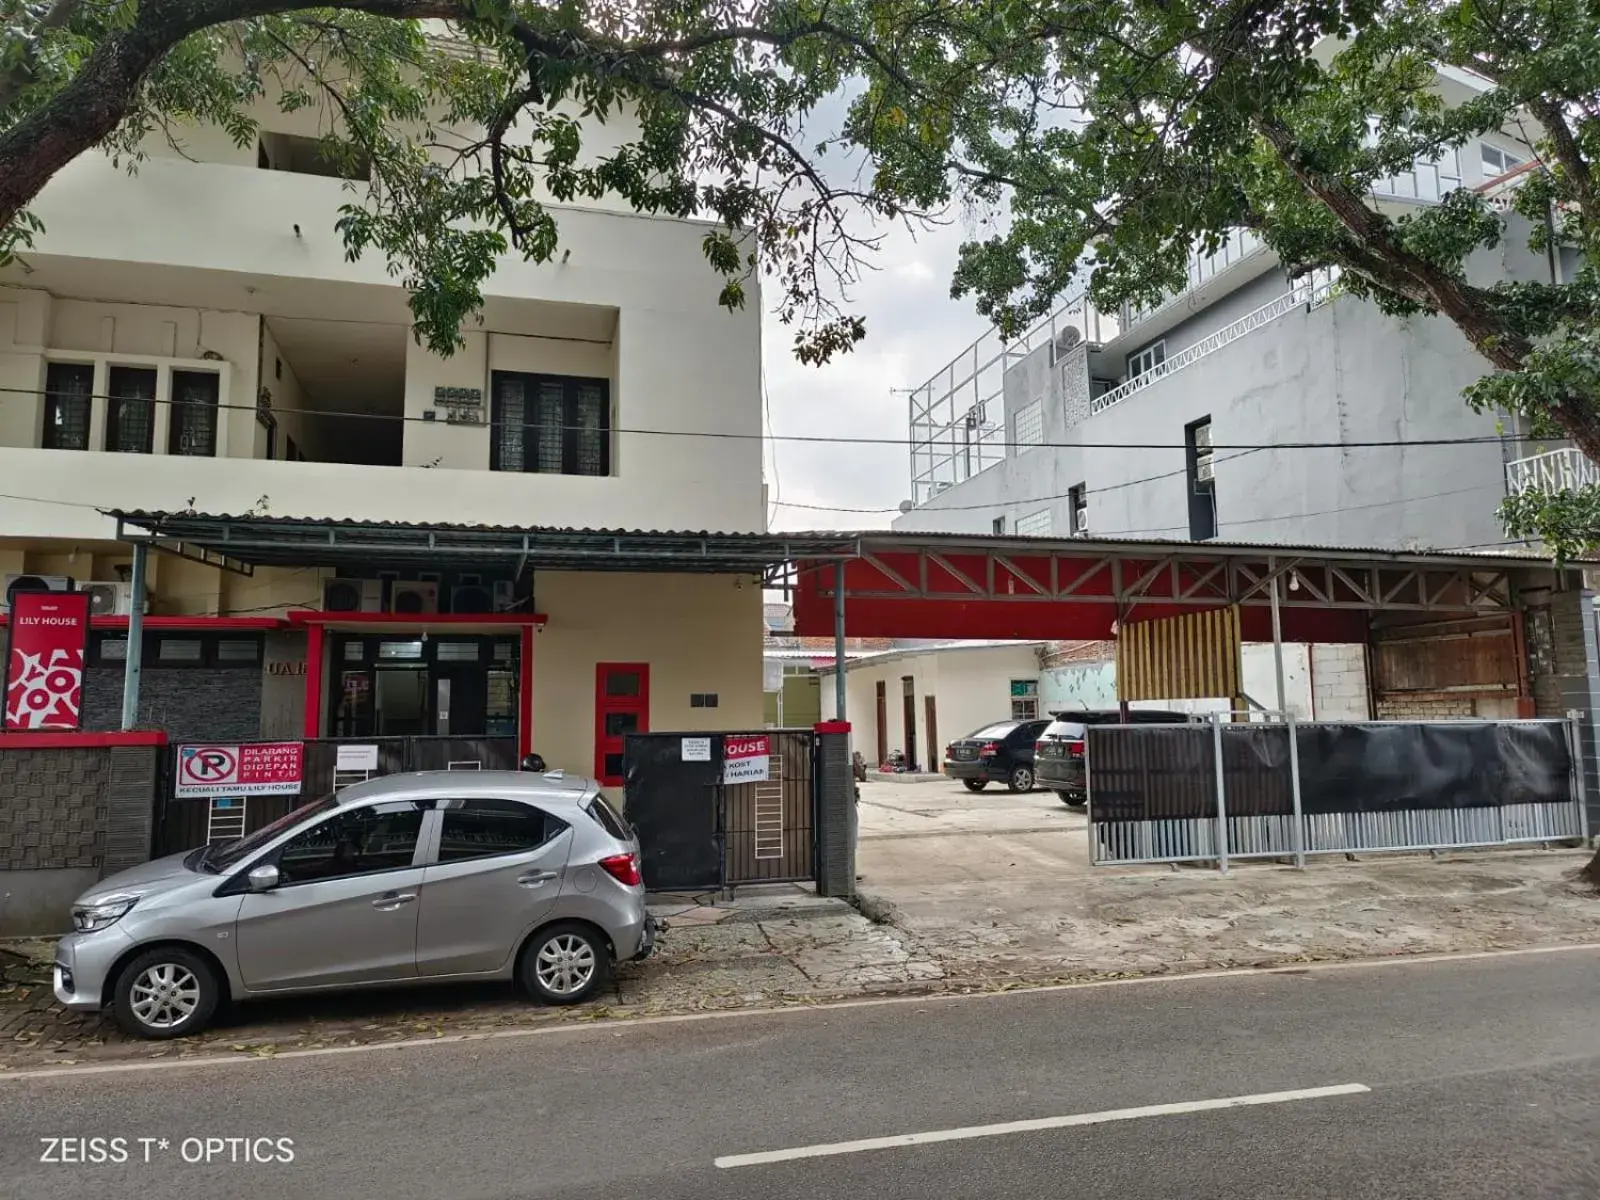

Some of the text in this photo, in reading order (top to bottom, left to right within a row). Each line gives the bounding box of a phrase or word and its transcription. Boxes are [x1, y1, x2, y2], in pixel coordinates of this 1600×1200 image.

[19, 616, 78, 626] LILY HOUSE
[244, 747, 298, 756] DILARANG
[243, 755, 297, 763] PARKIR
[243, 763, 297, 771] DIDEPAN
[728, 759, 752, 769] KOST
[179, 785, 219, 793] KECUALI
[248, 784, 267, 792] LILY
[268, 783, 299, 791] HOUSE
